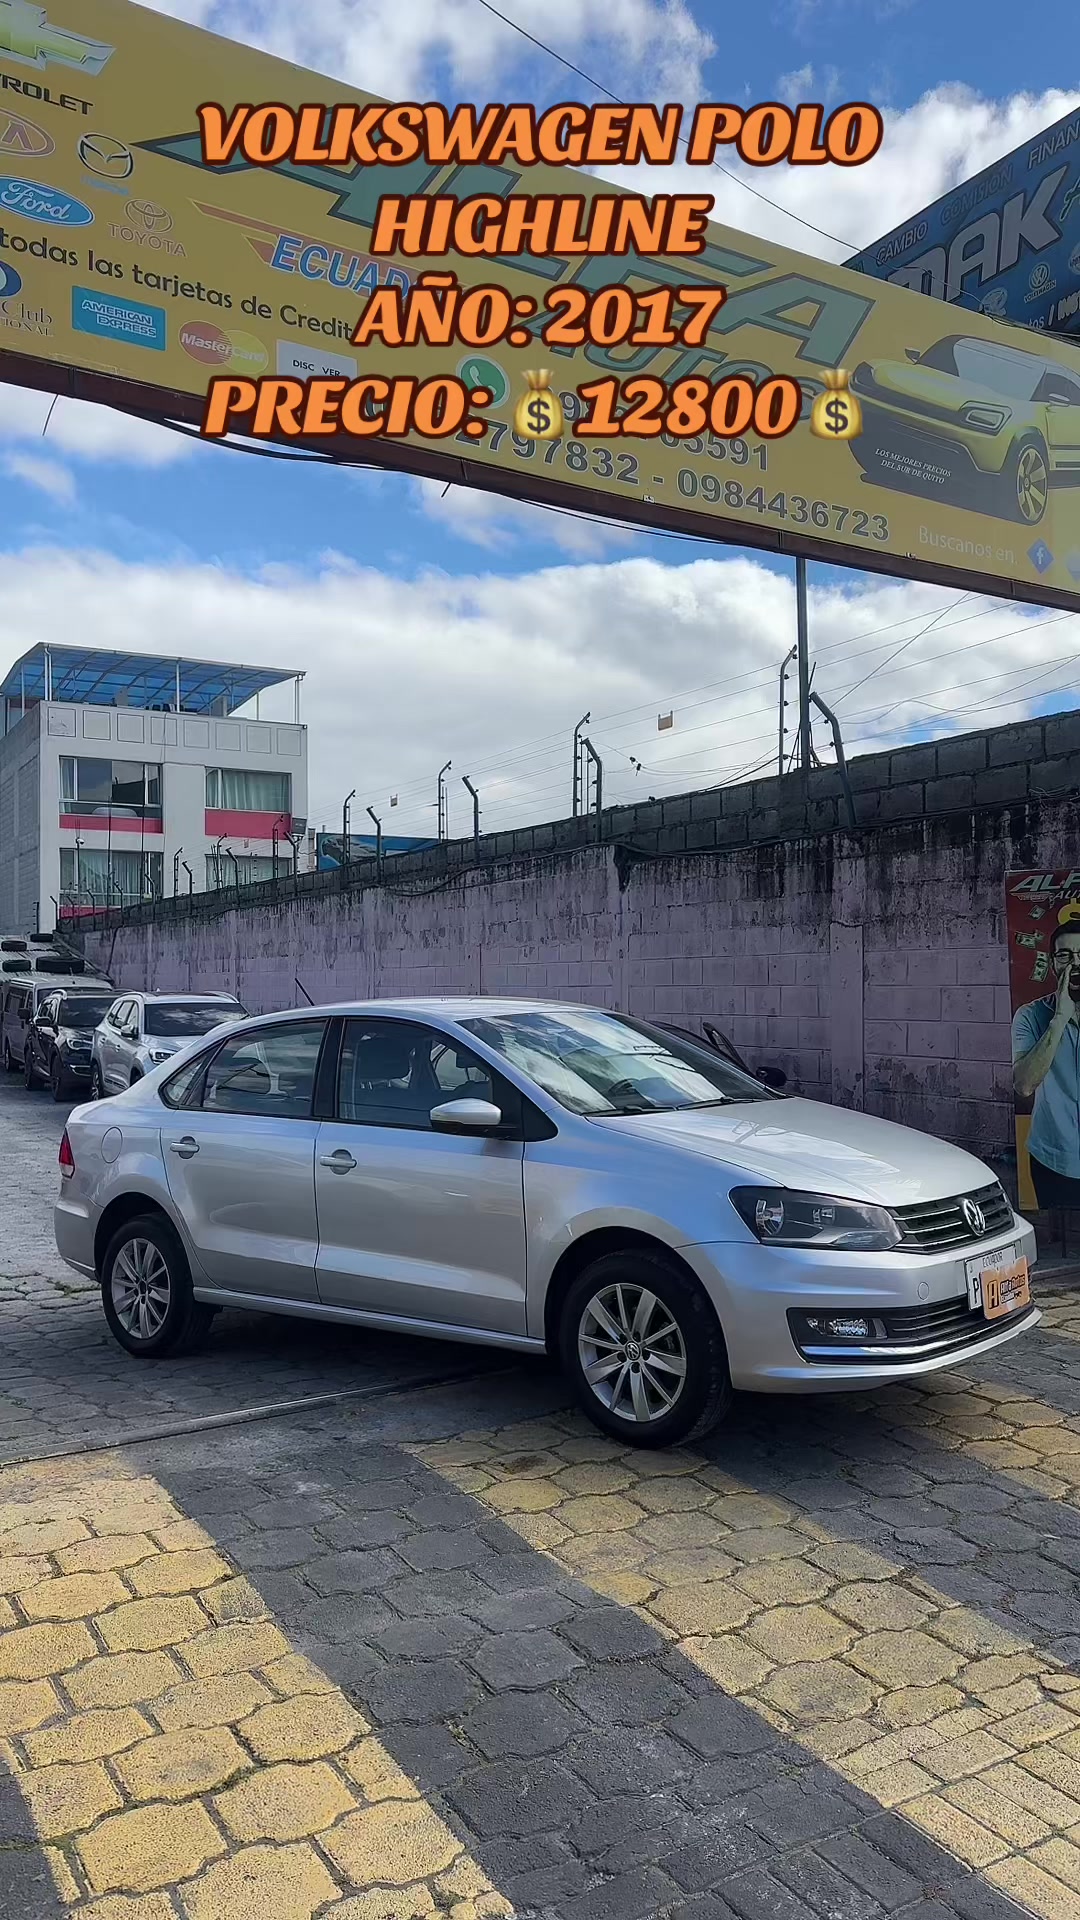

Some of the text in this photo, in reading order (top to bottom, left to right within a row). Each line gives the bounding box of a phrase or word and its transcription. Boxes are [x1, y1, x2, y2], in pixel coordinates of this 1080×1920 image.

[0, 73, 94, 115] ROLET
[1, 182, 70, 220] Ford
[108, 222, 187, 258] TOYOTA
[876, 221, 929, 265] CAMBIO
[270, 234, 432, 299] ECUAD
[0, 228, 354, 343] todas las tarjetas de Credit
[1, 300, 53, 324] Club
[81, 299, 153, 327] AMERICAN
[96, 313, 157, 338] EXPRESS
[181, 331, 266, 363] MasterCard
[875, 448, 952, 477] LOS MEJORES PRECIOS
[880, 459, 945, 484] DEL SUR DE QUITO
[677, 467, 890, 541] 0984436723
[919, 525, 992, 559] Buscanos
